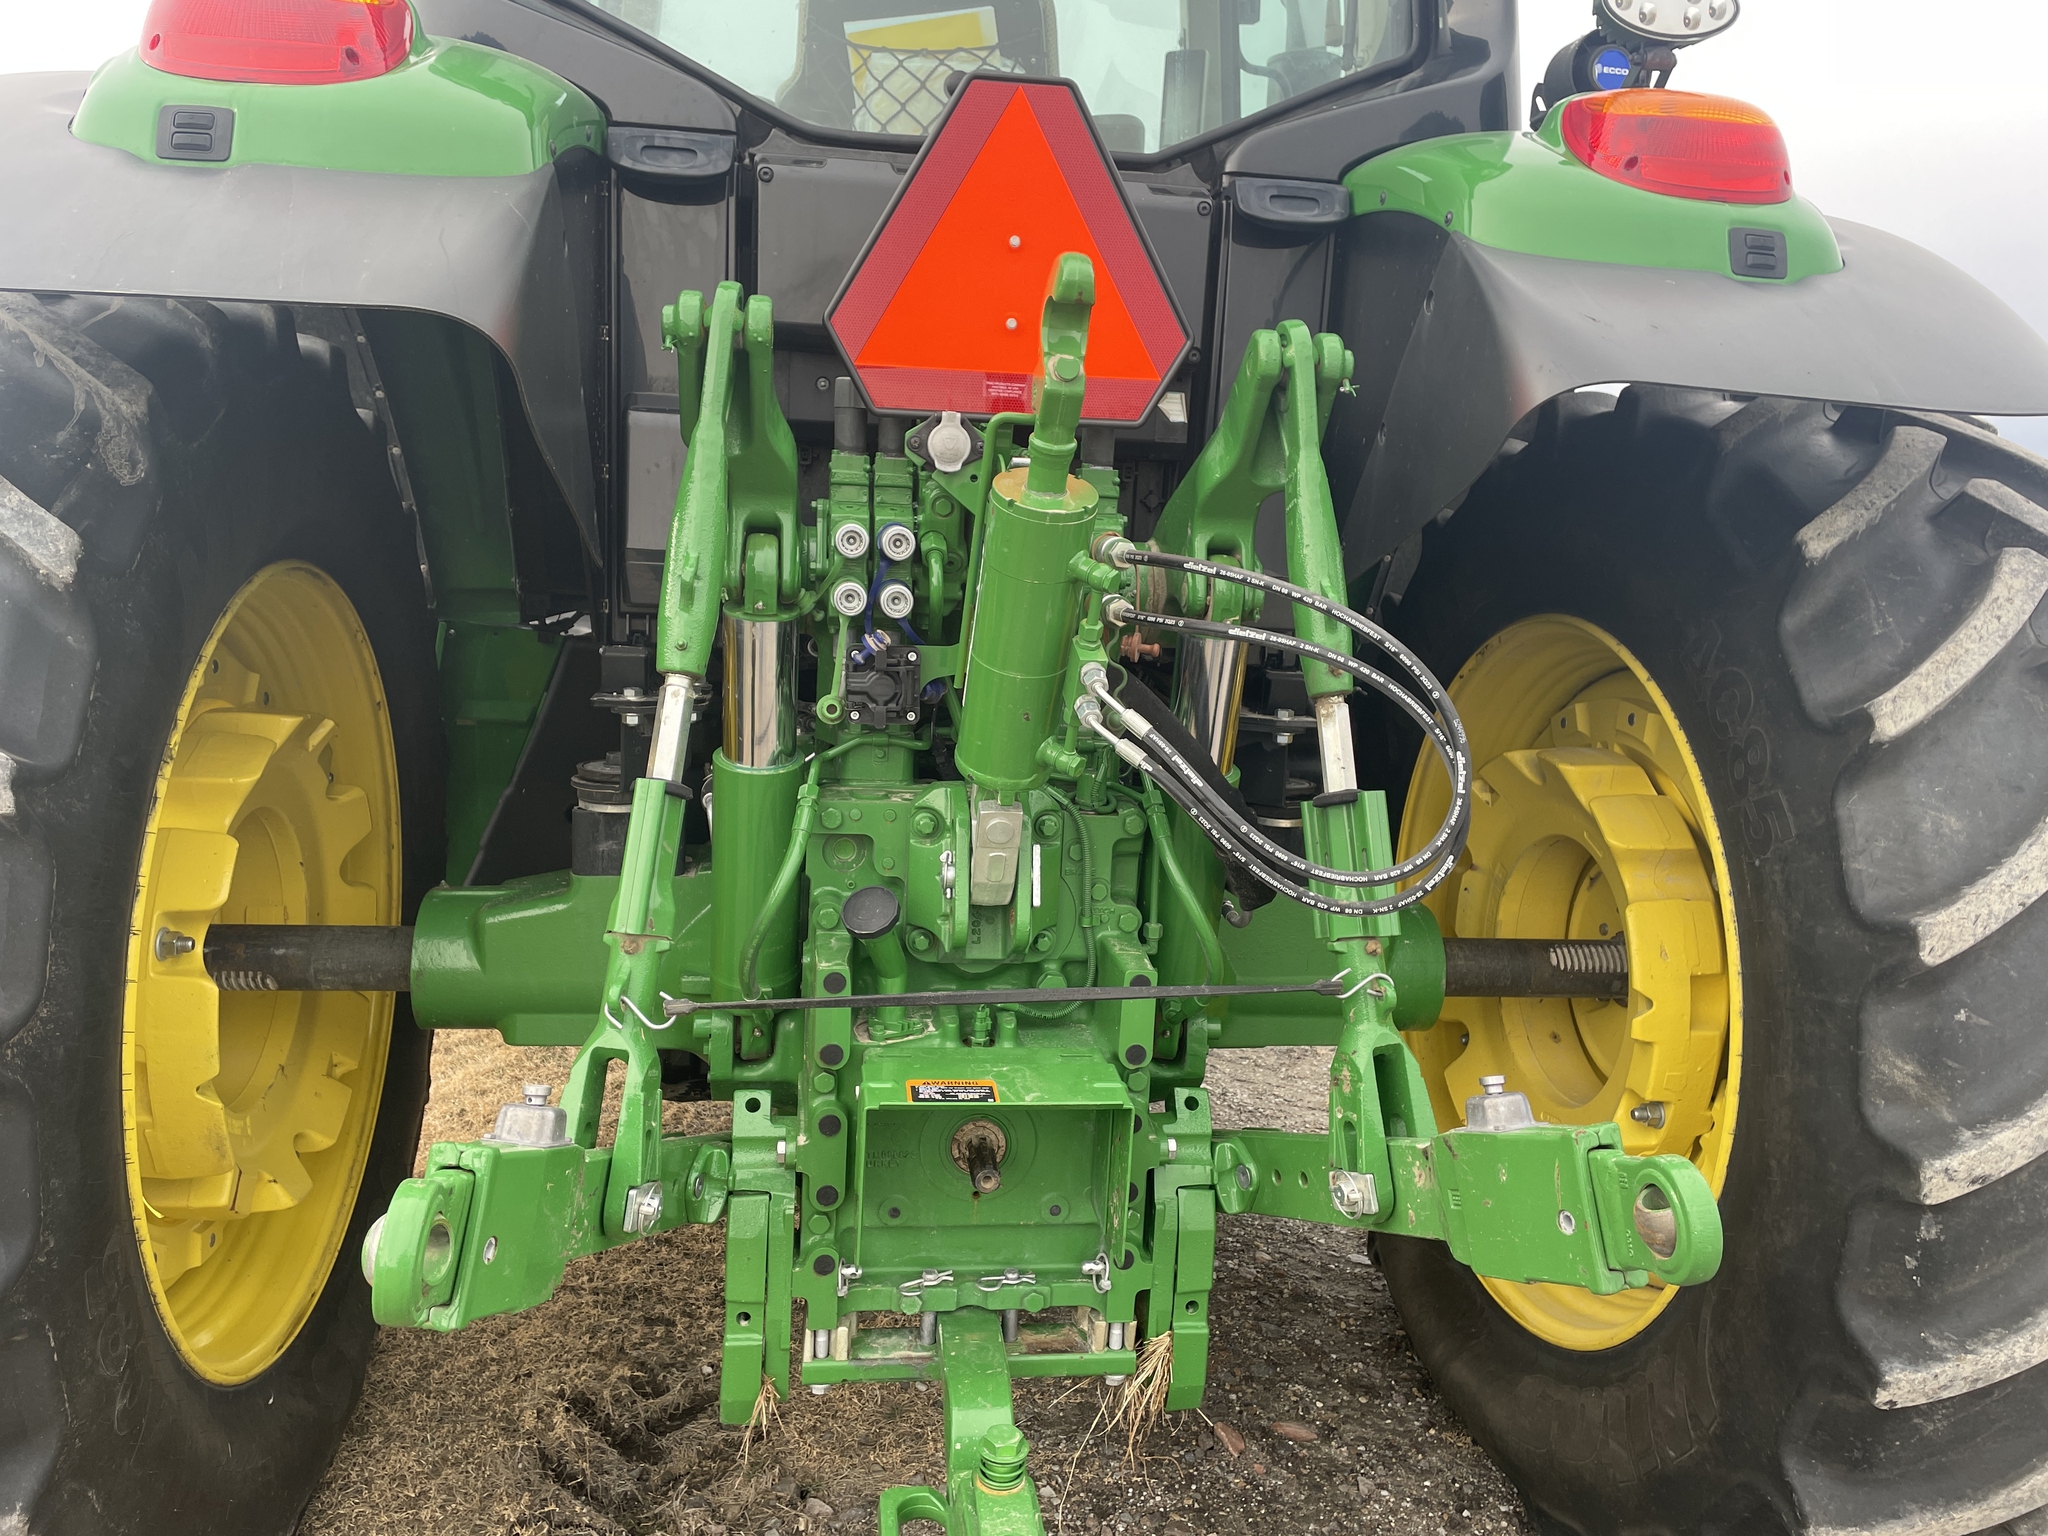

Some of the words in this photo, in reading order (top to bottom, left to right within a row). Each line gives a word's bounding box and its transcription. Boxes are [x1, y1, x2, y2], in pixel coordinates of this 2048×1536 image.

[1603, 66, 1629, 76] ECCO
[1184, 561, 1217, 575] dietzel
[1272, 584, 1280, 592] DN
[1303, 596, 1313, 604] 420
[1315, 600, 1327, 610] BAR
[1331, 609, 1381, 641] HOCHABRIEBFEST
[1411, 665, 1422, 676] PSI
[1228, 627, 1266, 641] dietzel
[1327, 652, 1337, 660] DN
[1348, 660, 1359, 668] WP
[1359, 666, 1370, 676] 420
[1371, 672, 1385, 684] BAR
[1388, 683, 1434, 725] HOCHABRIEBFEST
[1171, 755, 1204, 787] dietzel
[1456, 751, 1466, 794] dietzel
[1199, 816, 1211, 829] 2Q23
[1211, 828, 1220, 839] PSI
[1264, 844, 1274, 853] PSI
[1422, 851, 1432, 860] DN
[1310, 868, 1367, 882] HOCHABRIEBFEST
[1403, 864, 1414, 873] WP
[1425, 855, 1454, 891] dietzel
[1249, 864, 1297, 898] HOCHABRIEBFEST
[1301, 896, 1315, 906] BAR
